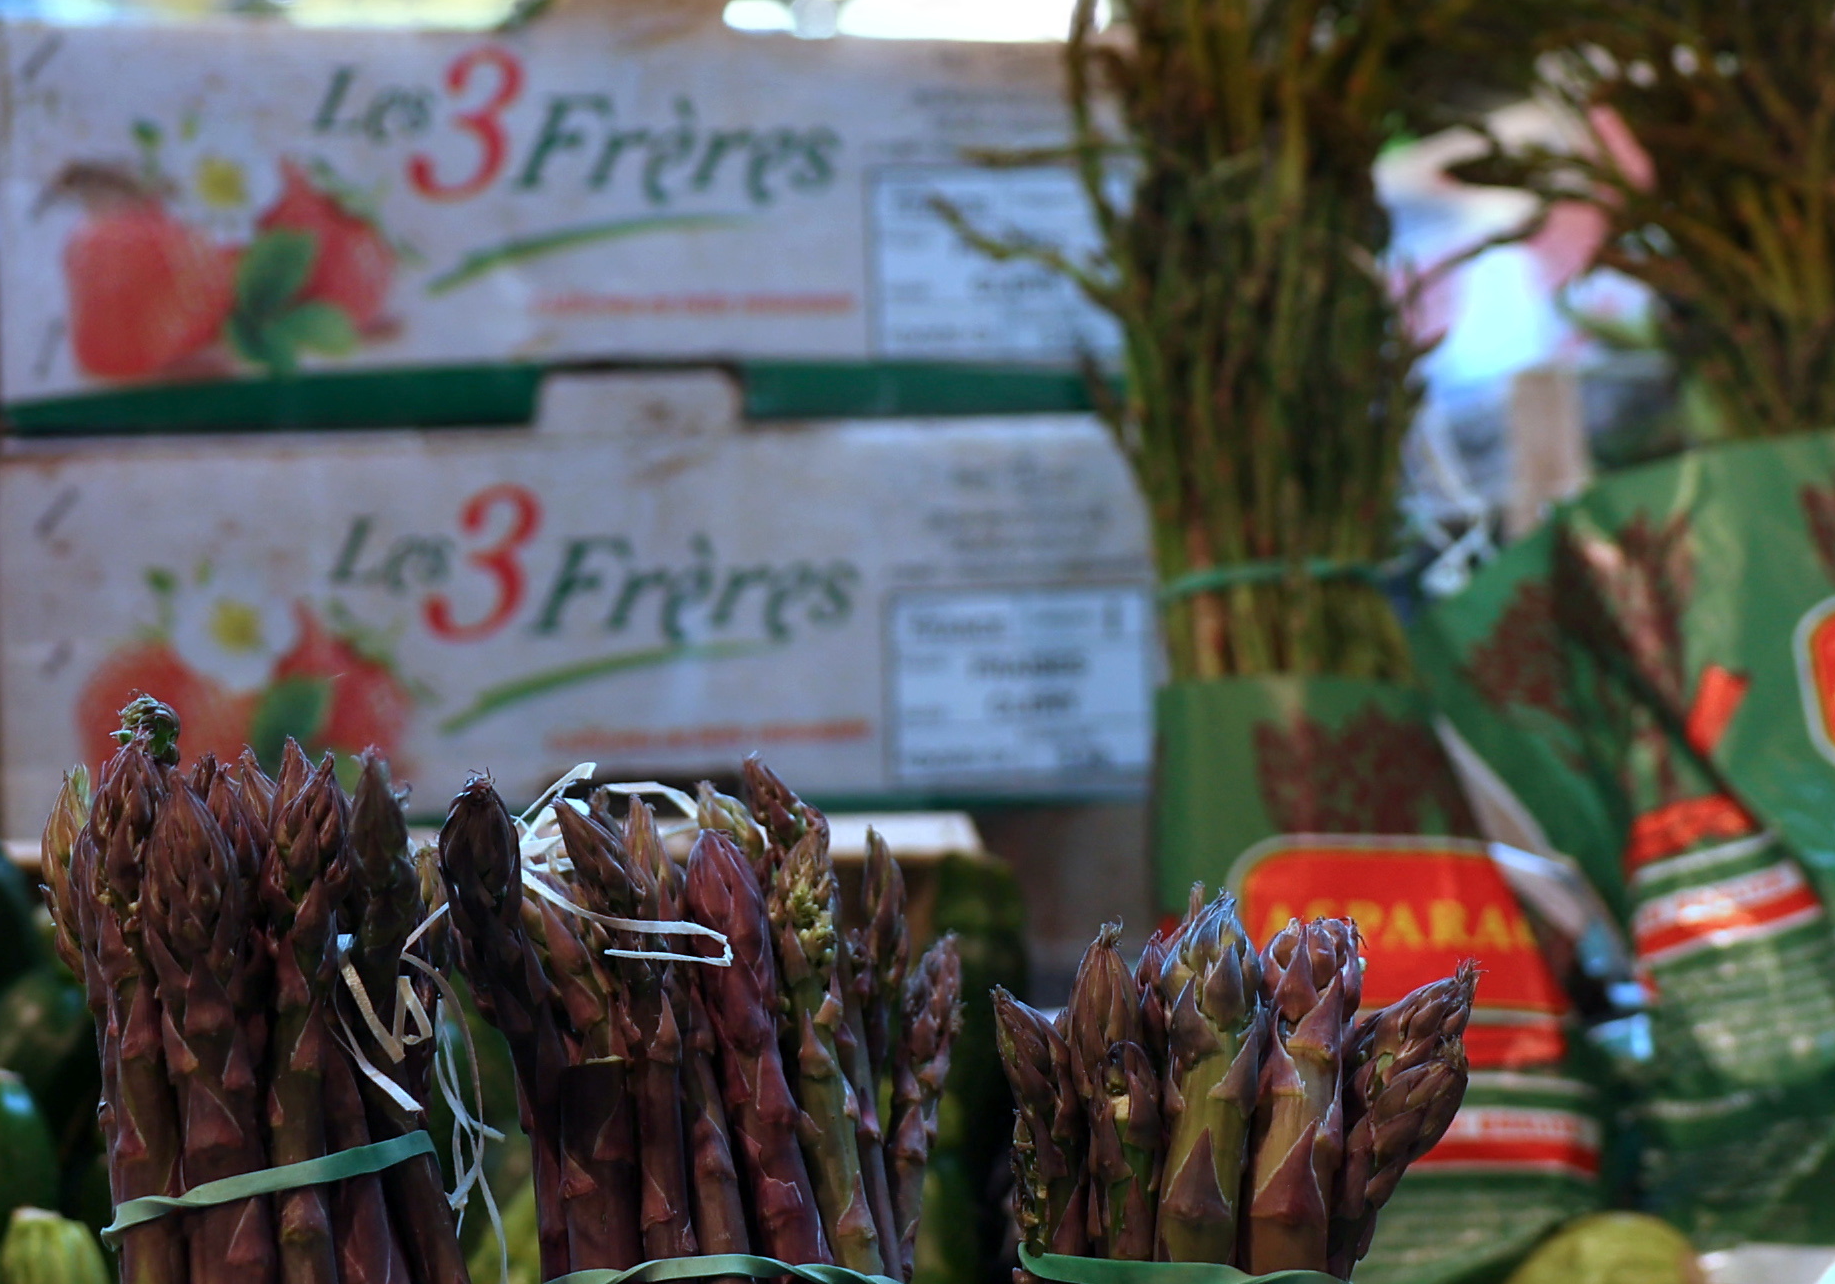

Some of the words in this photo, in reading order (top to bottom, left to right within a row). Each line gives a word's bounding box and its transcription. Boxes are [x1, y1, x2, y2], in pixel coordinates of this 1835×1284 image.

[407, 47, 524, 203] 3
[514, 93, 842, 204] Frères
[424, 482, 542, 643] 3
[531, 532, 862, 643] Frères
